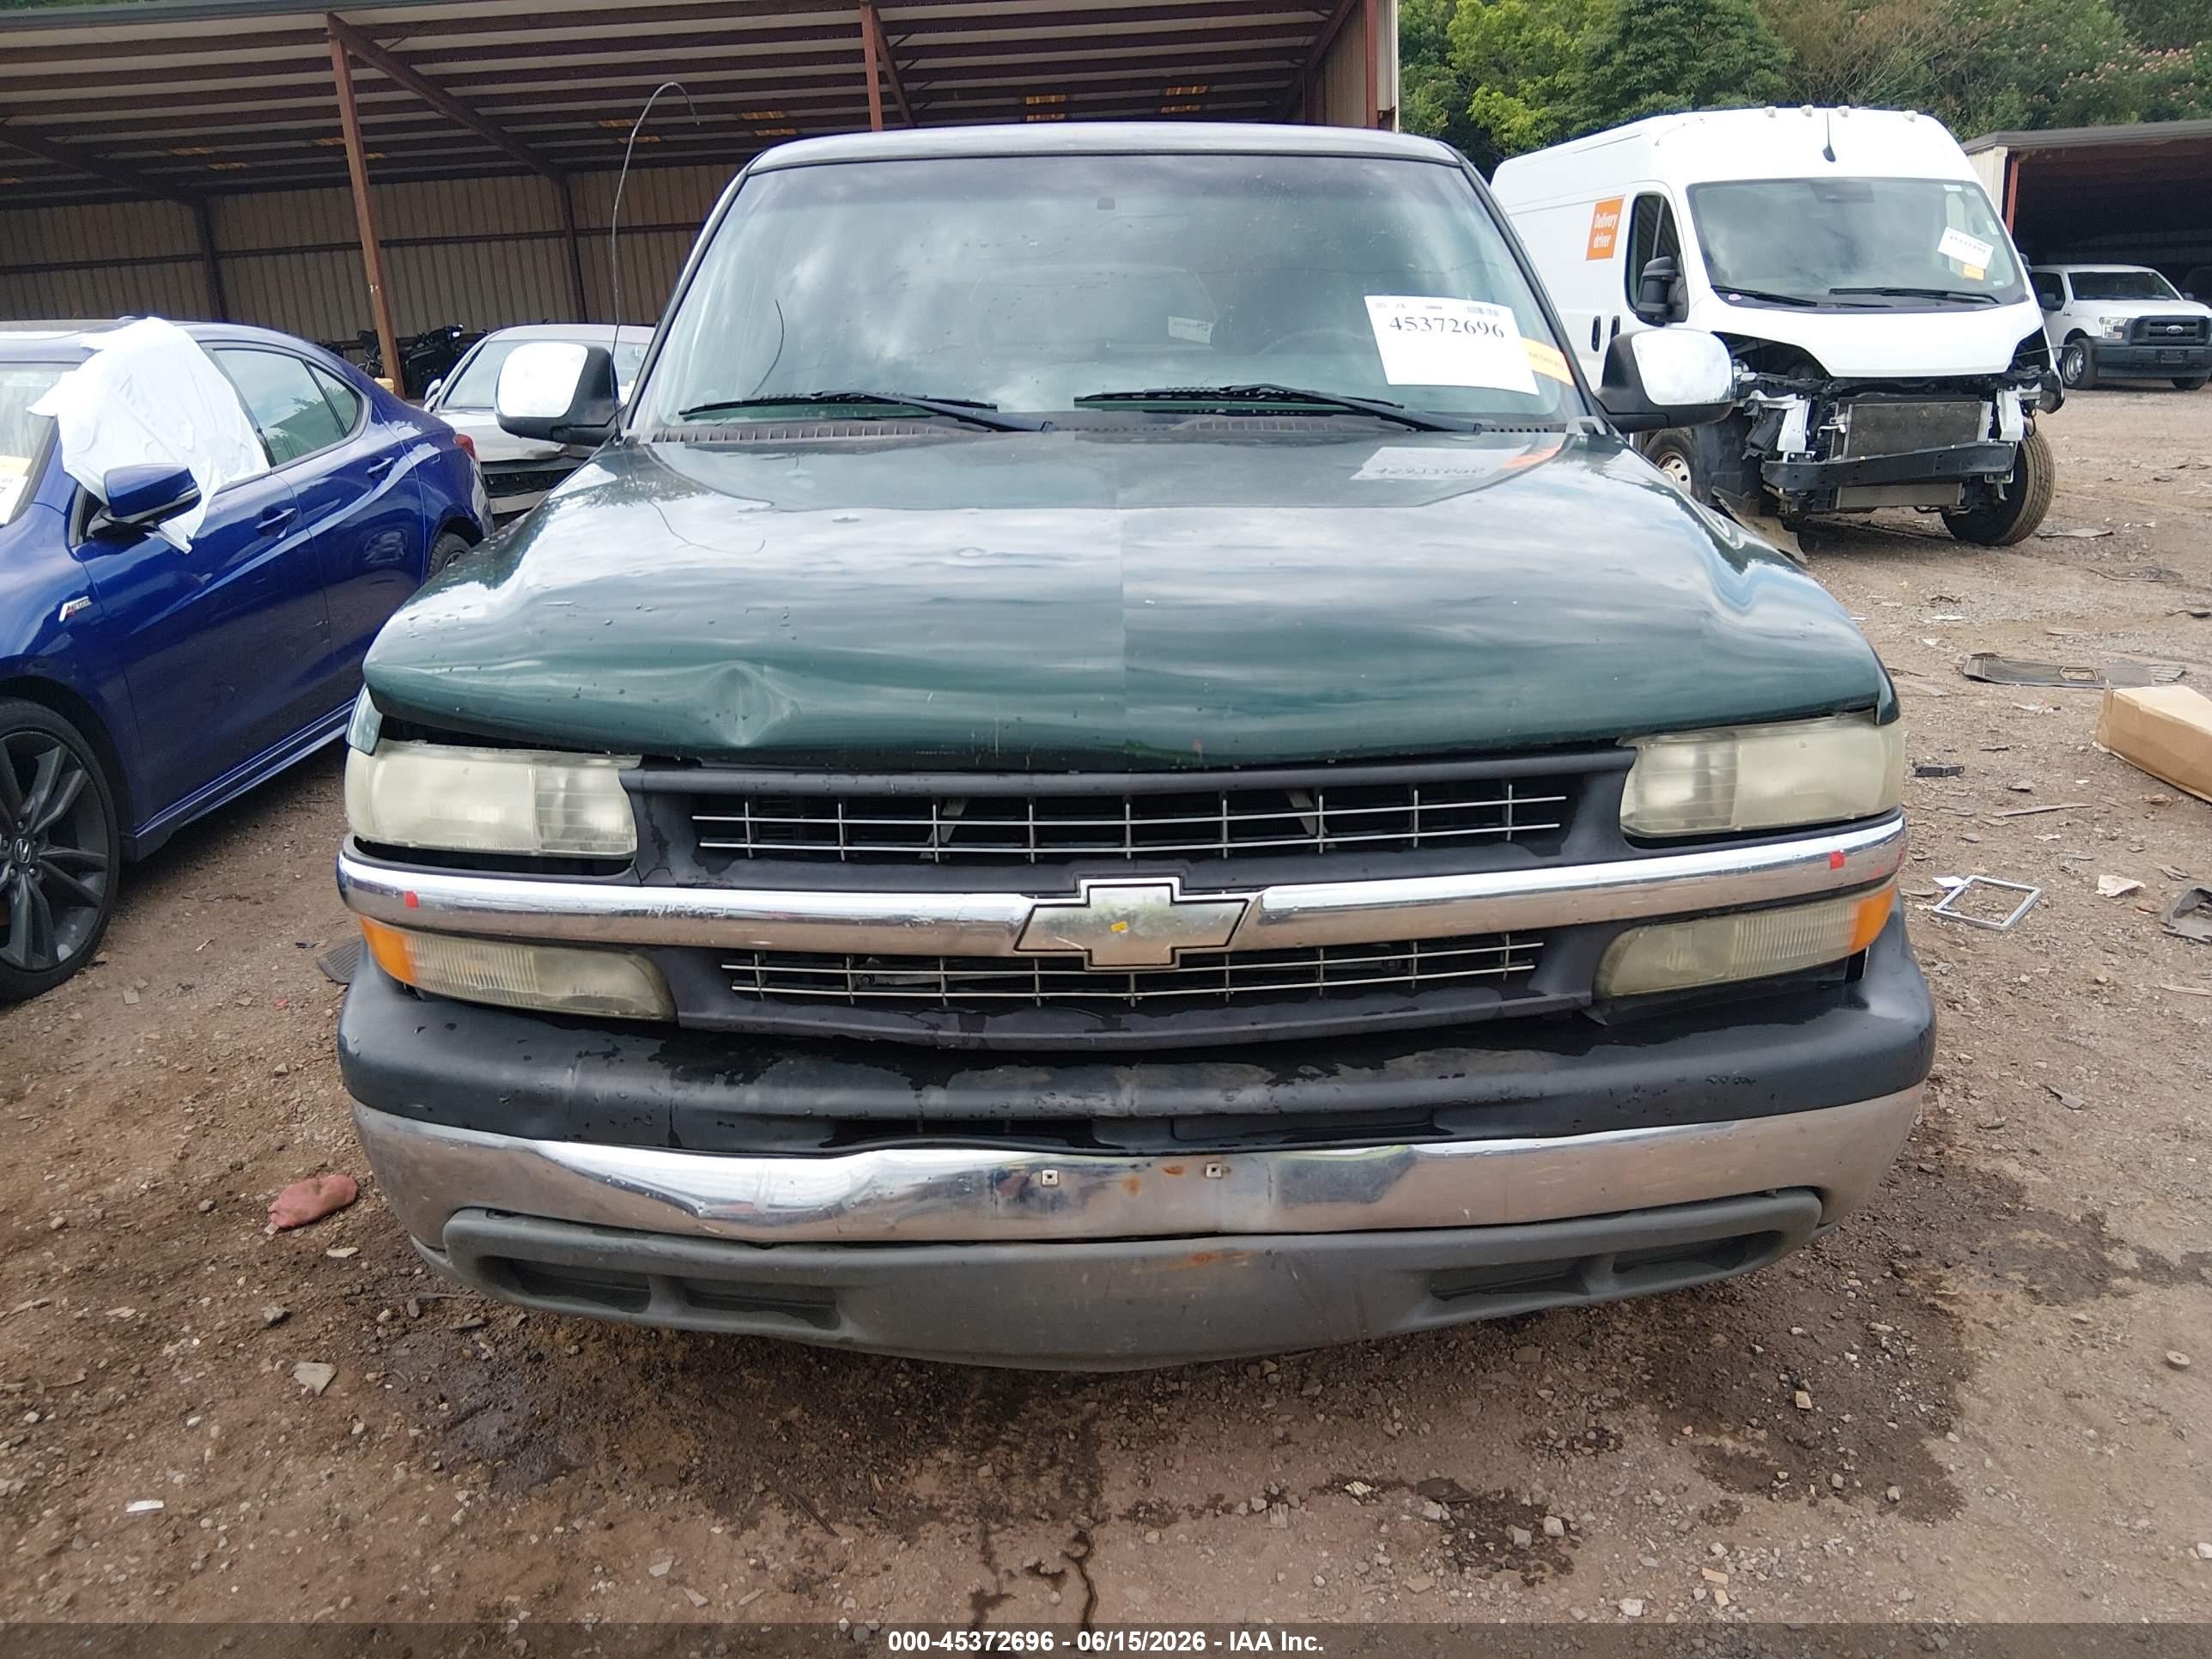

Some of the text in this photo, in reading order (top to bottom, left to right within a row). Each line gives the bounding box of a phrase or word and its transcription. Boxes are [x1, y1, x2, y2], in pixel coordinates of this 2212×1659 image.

[1594, 212, 1619, 230] Delivery
[1593, 232, 1612, 249] driver
[1389, 315, 1504, 337] 45372696
